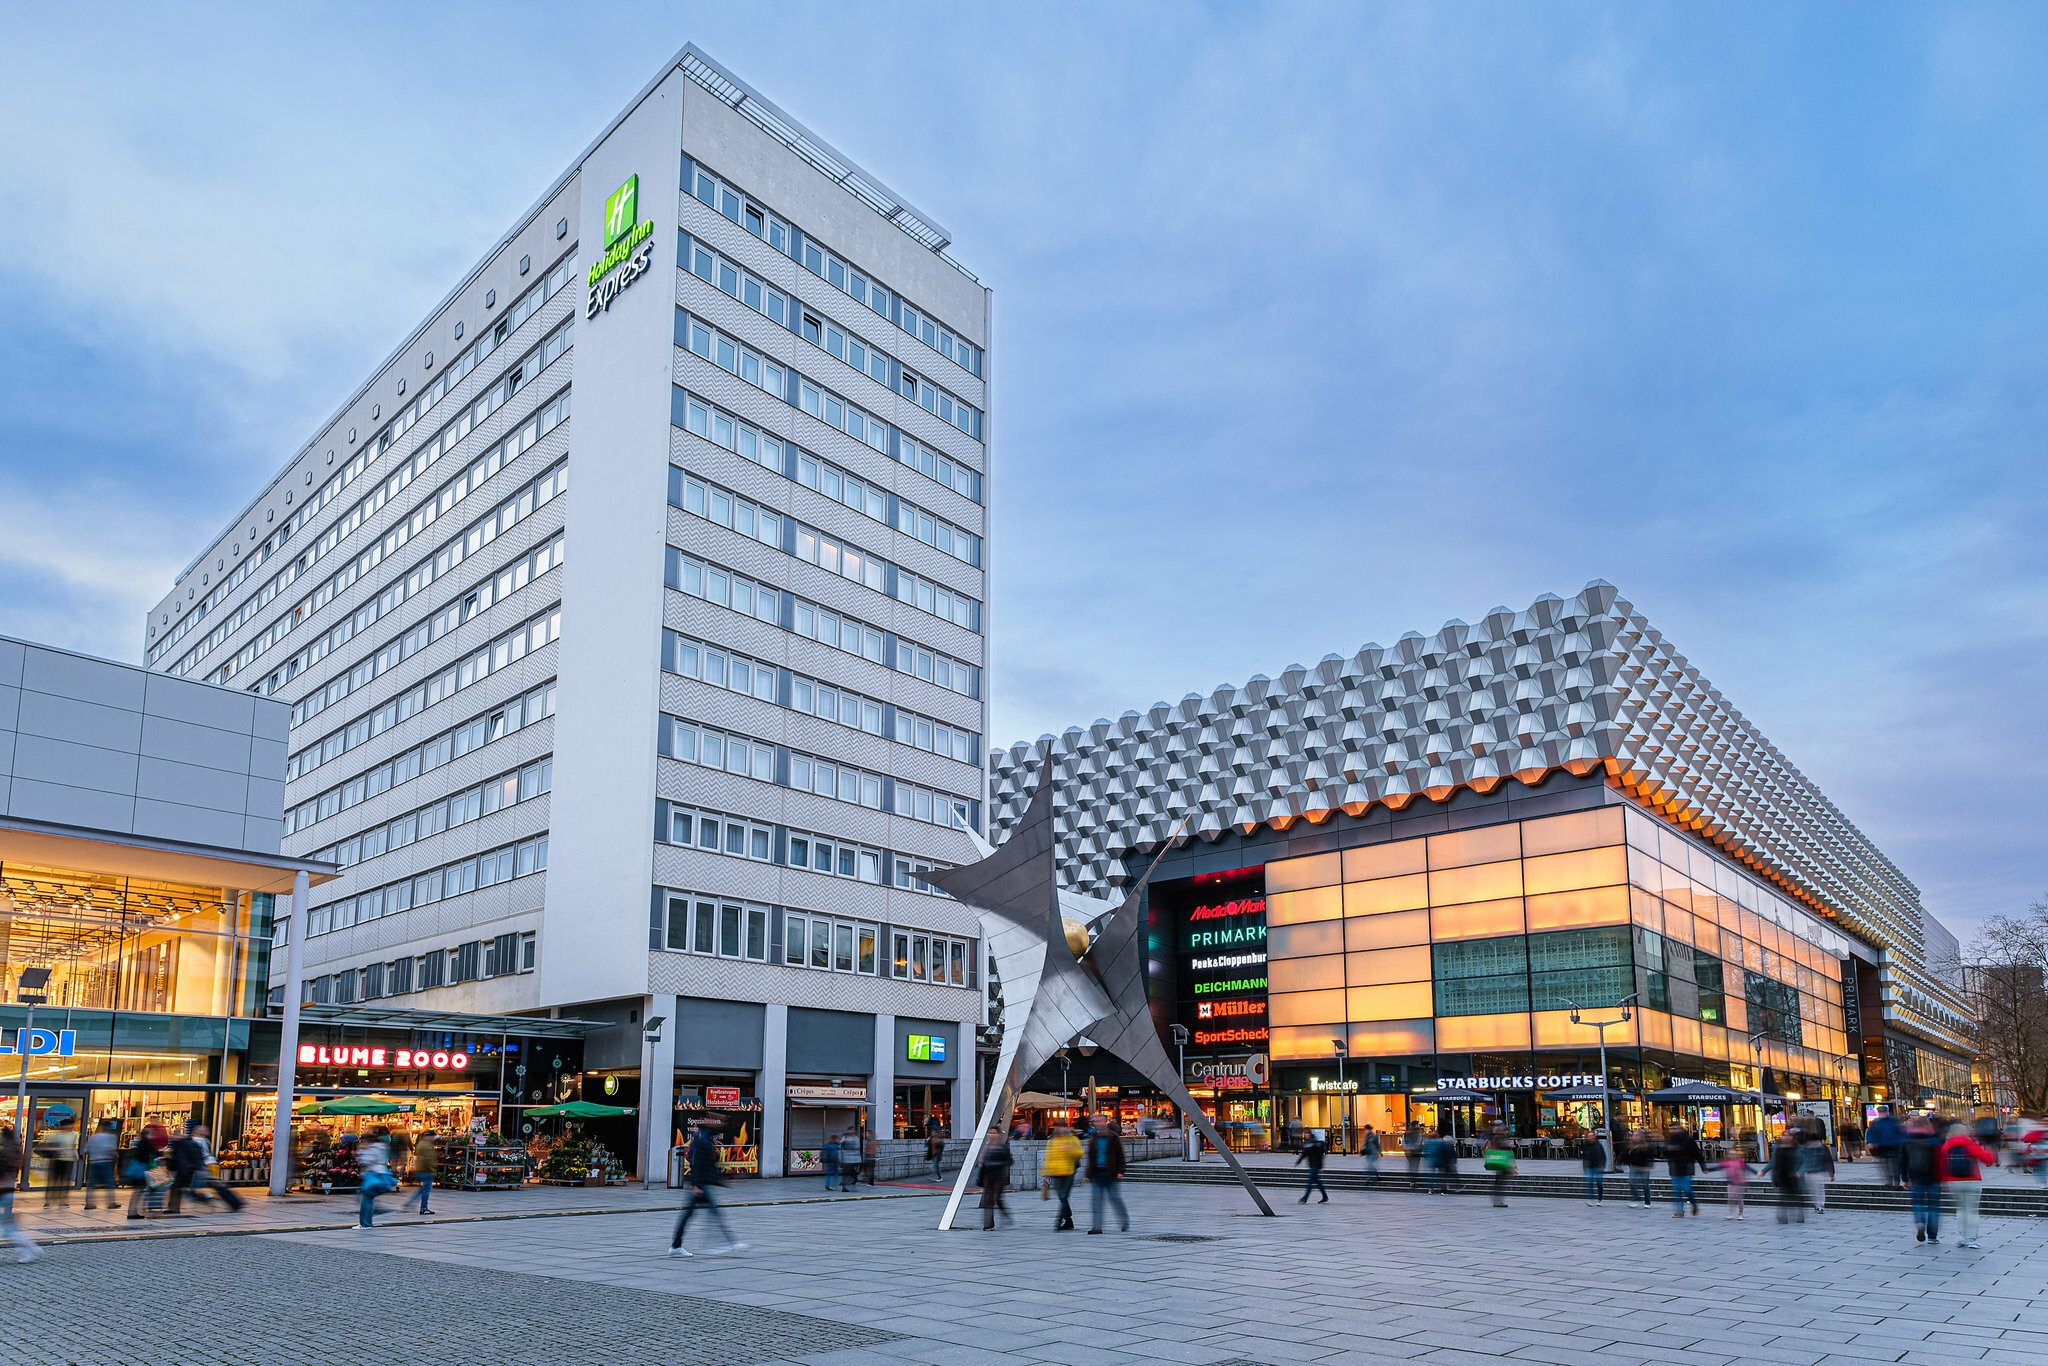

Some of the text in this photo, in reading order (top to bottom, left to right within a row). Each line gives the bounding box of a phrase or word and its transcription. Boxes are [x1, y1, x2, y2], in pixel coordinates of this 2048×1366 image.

[587, 218, 653, 287] Holiday Inn
[586, 246, 650, 320] Express
[1192, 926, 1266, 947] PRIMARK
[1194, 977, 1268, 994] DEICHMANN
[1213, 1000, 1266, 1017] Müller
[1844, 977, 1858, 1033] PRIMARK
[1195, 1027, 1269, 1045] SportScheck
[298, 1044, 470, 1070] BLUME 2000
[1204, 1074, 1249, 1088] Galerie
[1437, 1075, 1604, 1090] STARBUCKS COFFEE
